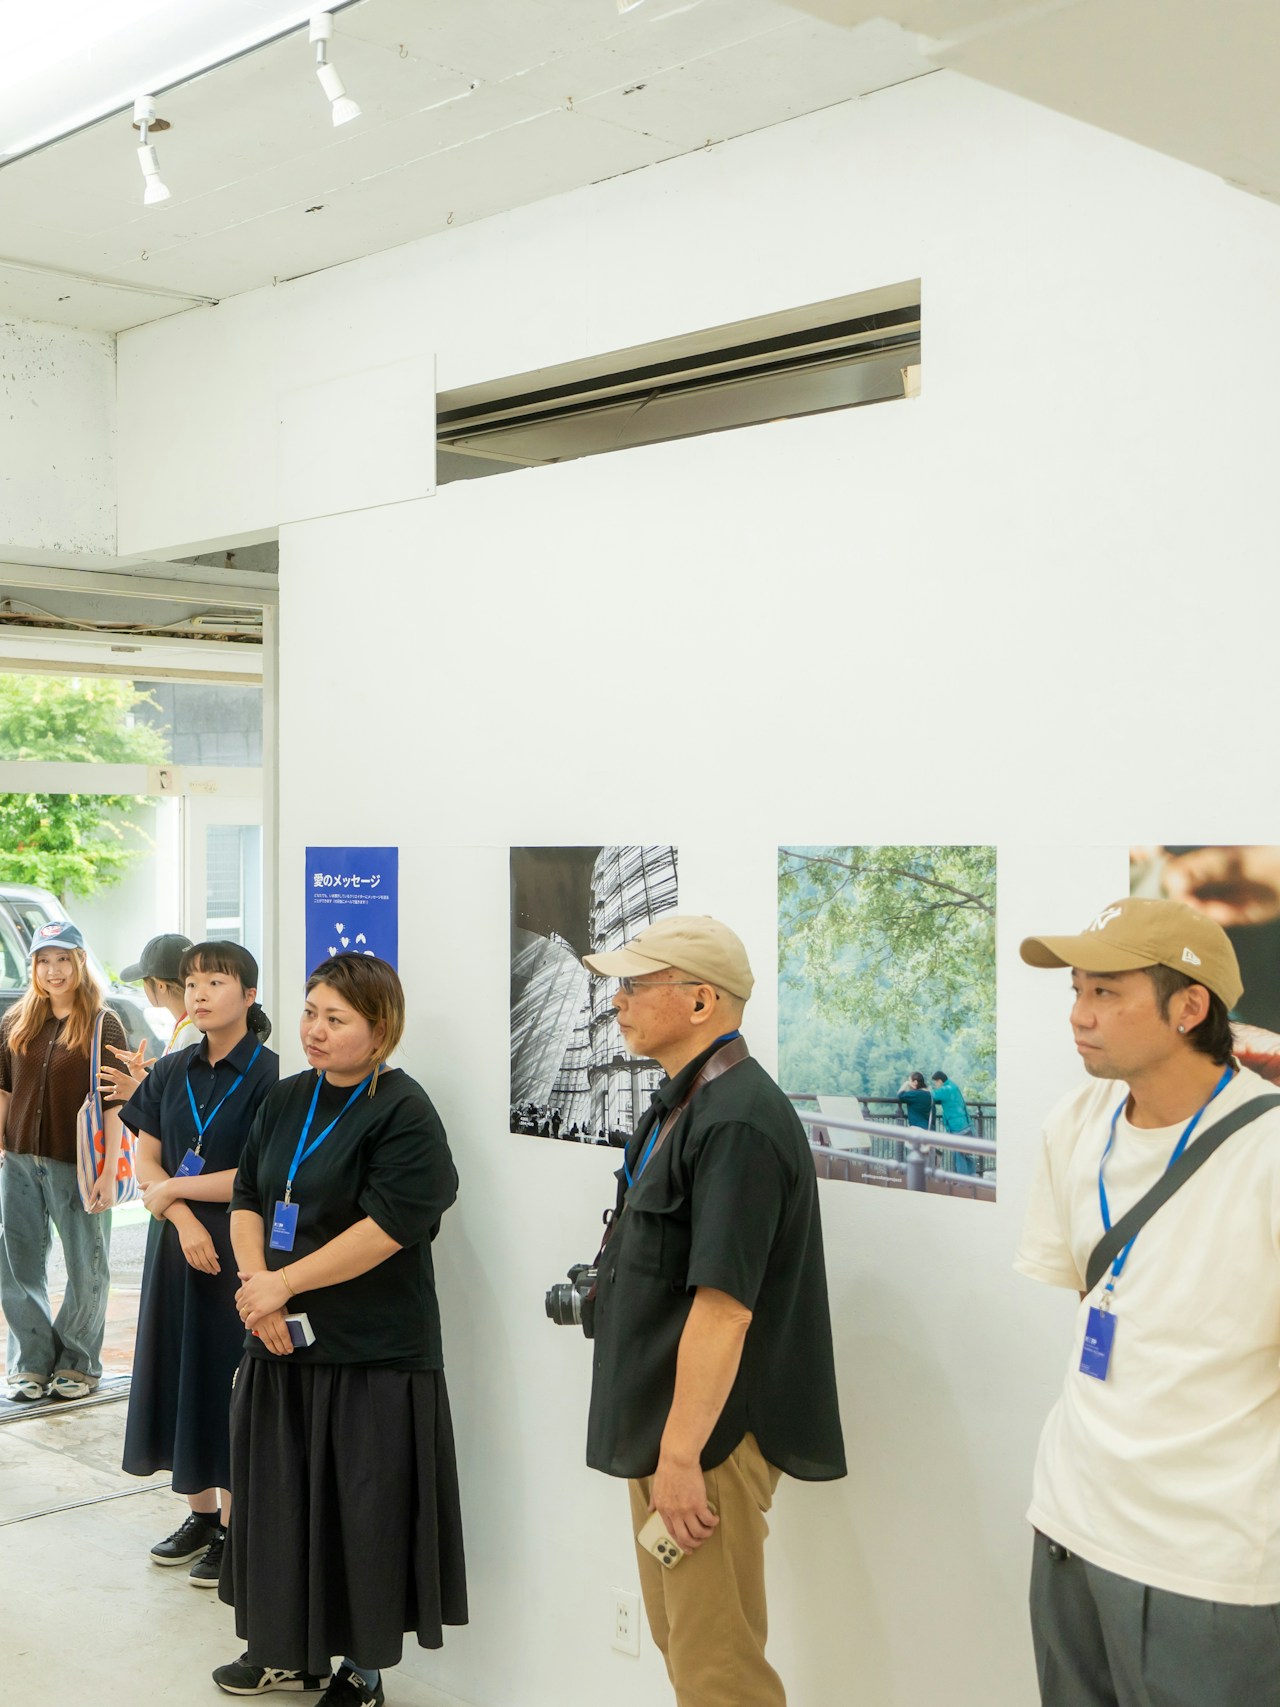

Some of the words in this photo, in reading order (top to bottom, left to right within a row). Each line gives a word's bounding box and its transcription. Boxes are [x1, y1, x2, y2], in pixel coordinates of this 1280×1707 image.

[313, 873, 380, 889] 愛のメッセージ
